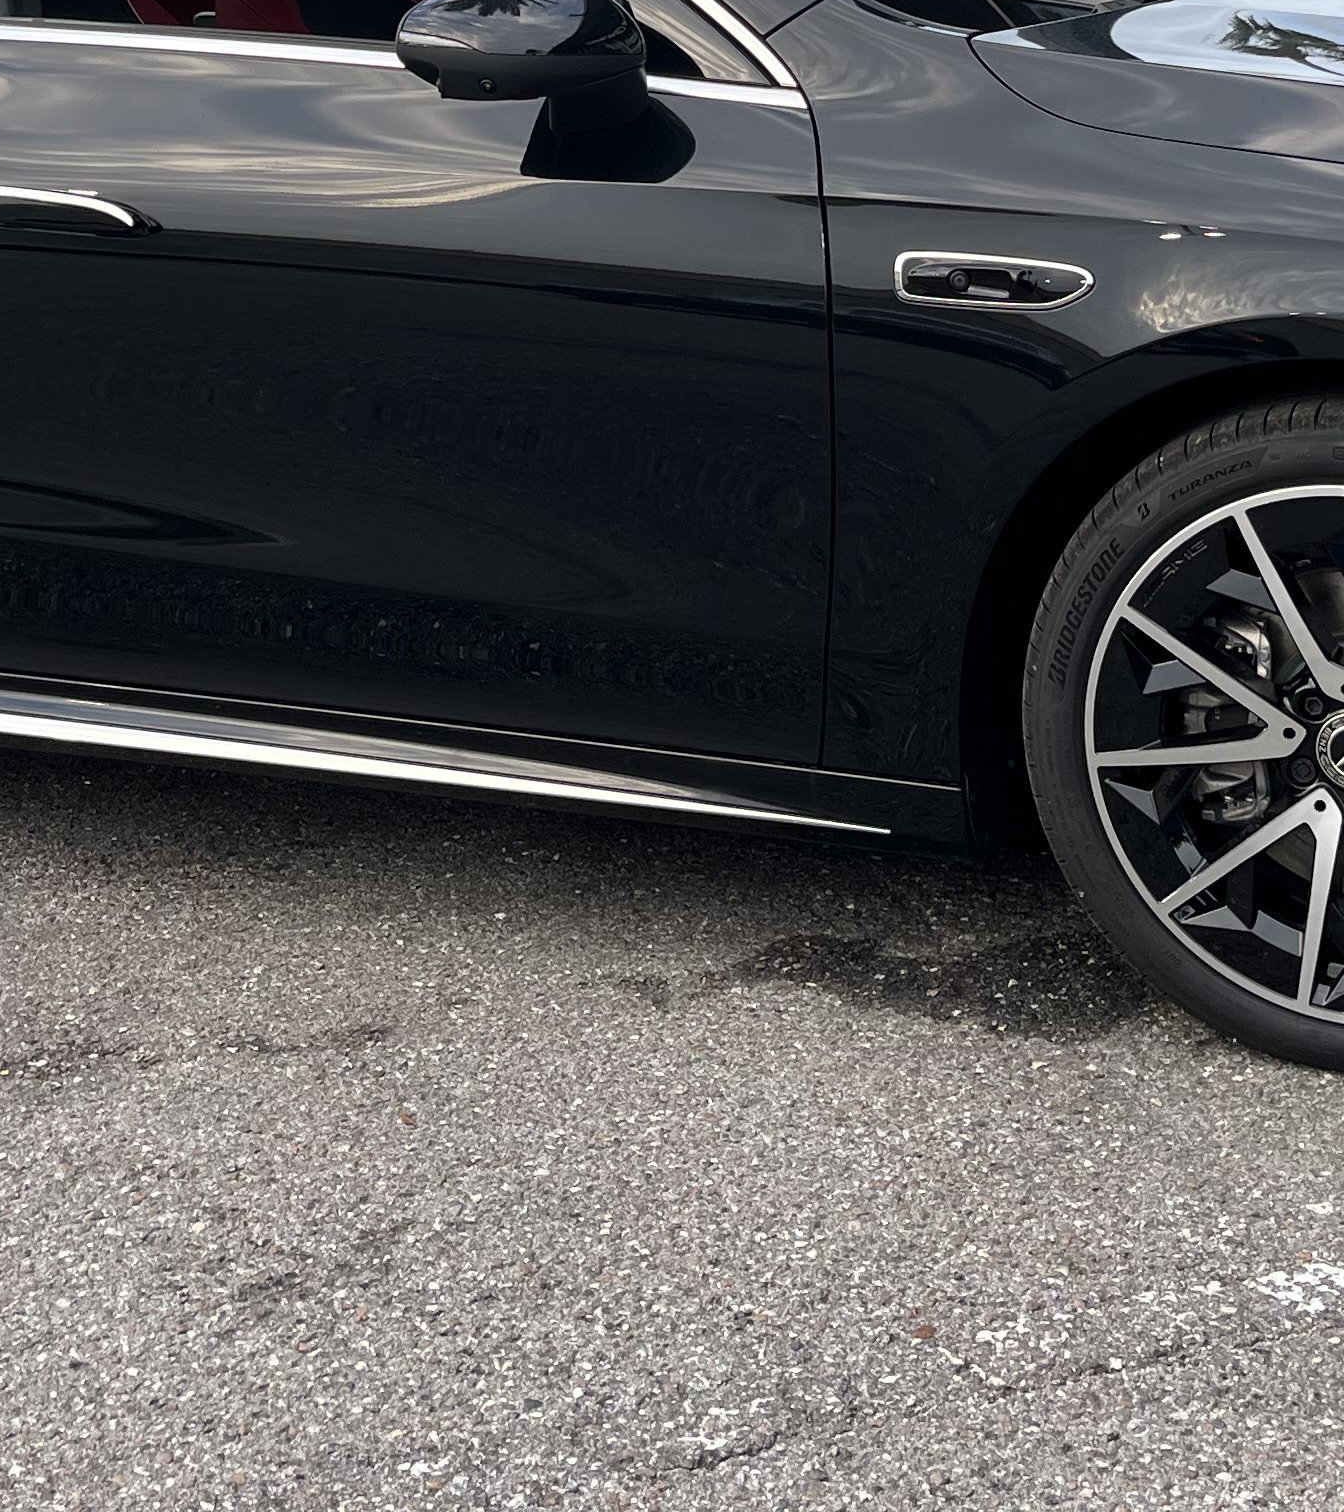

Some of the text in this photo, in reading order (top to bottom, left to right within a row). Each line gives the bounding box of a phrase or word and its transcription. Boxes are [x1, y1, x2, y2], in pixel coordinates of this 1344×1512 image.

[1167, 459, 1254, 501] TURANZA
[1048, 538, 1125, 687] BRIDGESTONE
[1318, 727, 1333, 753] BENZ
